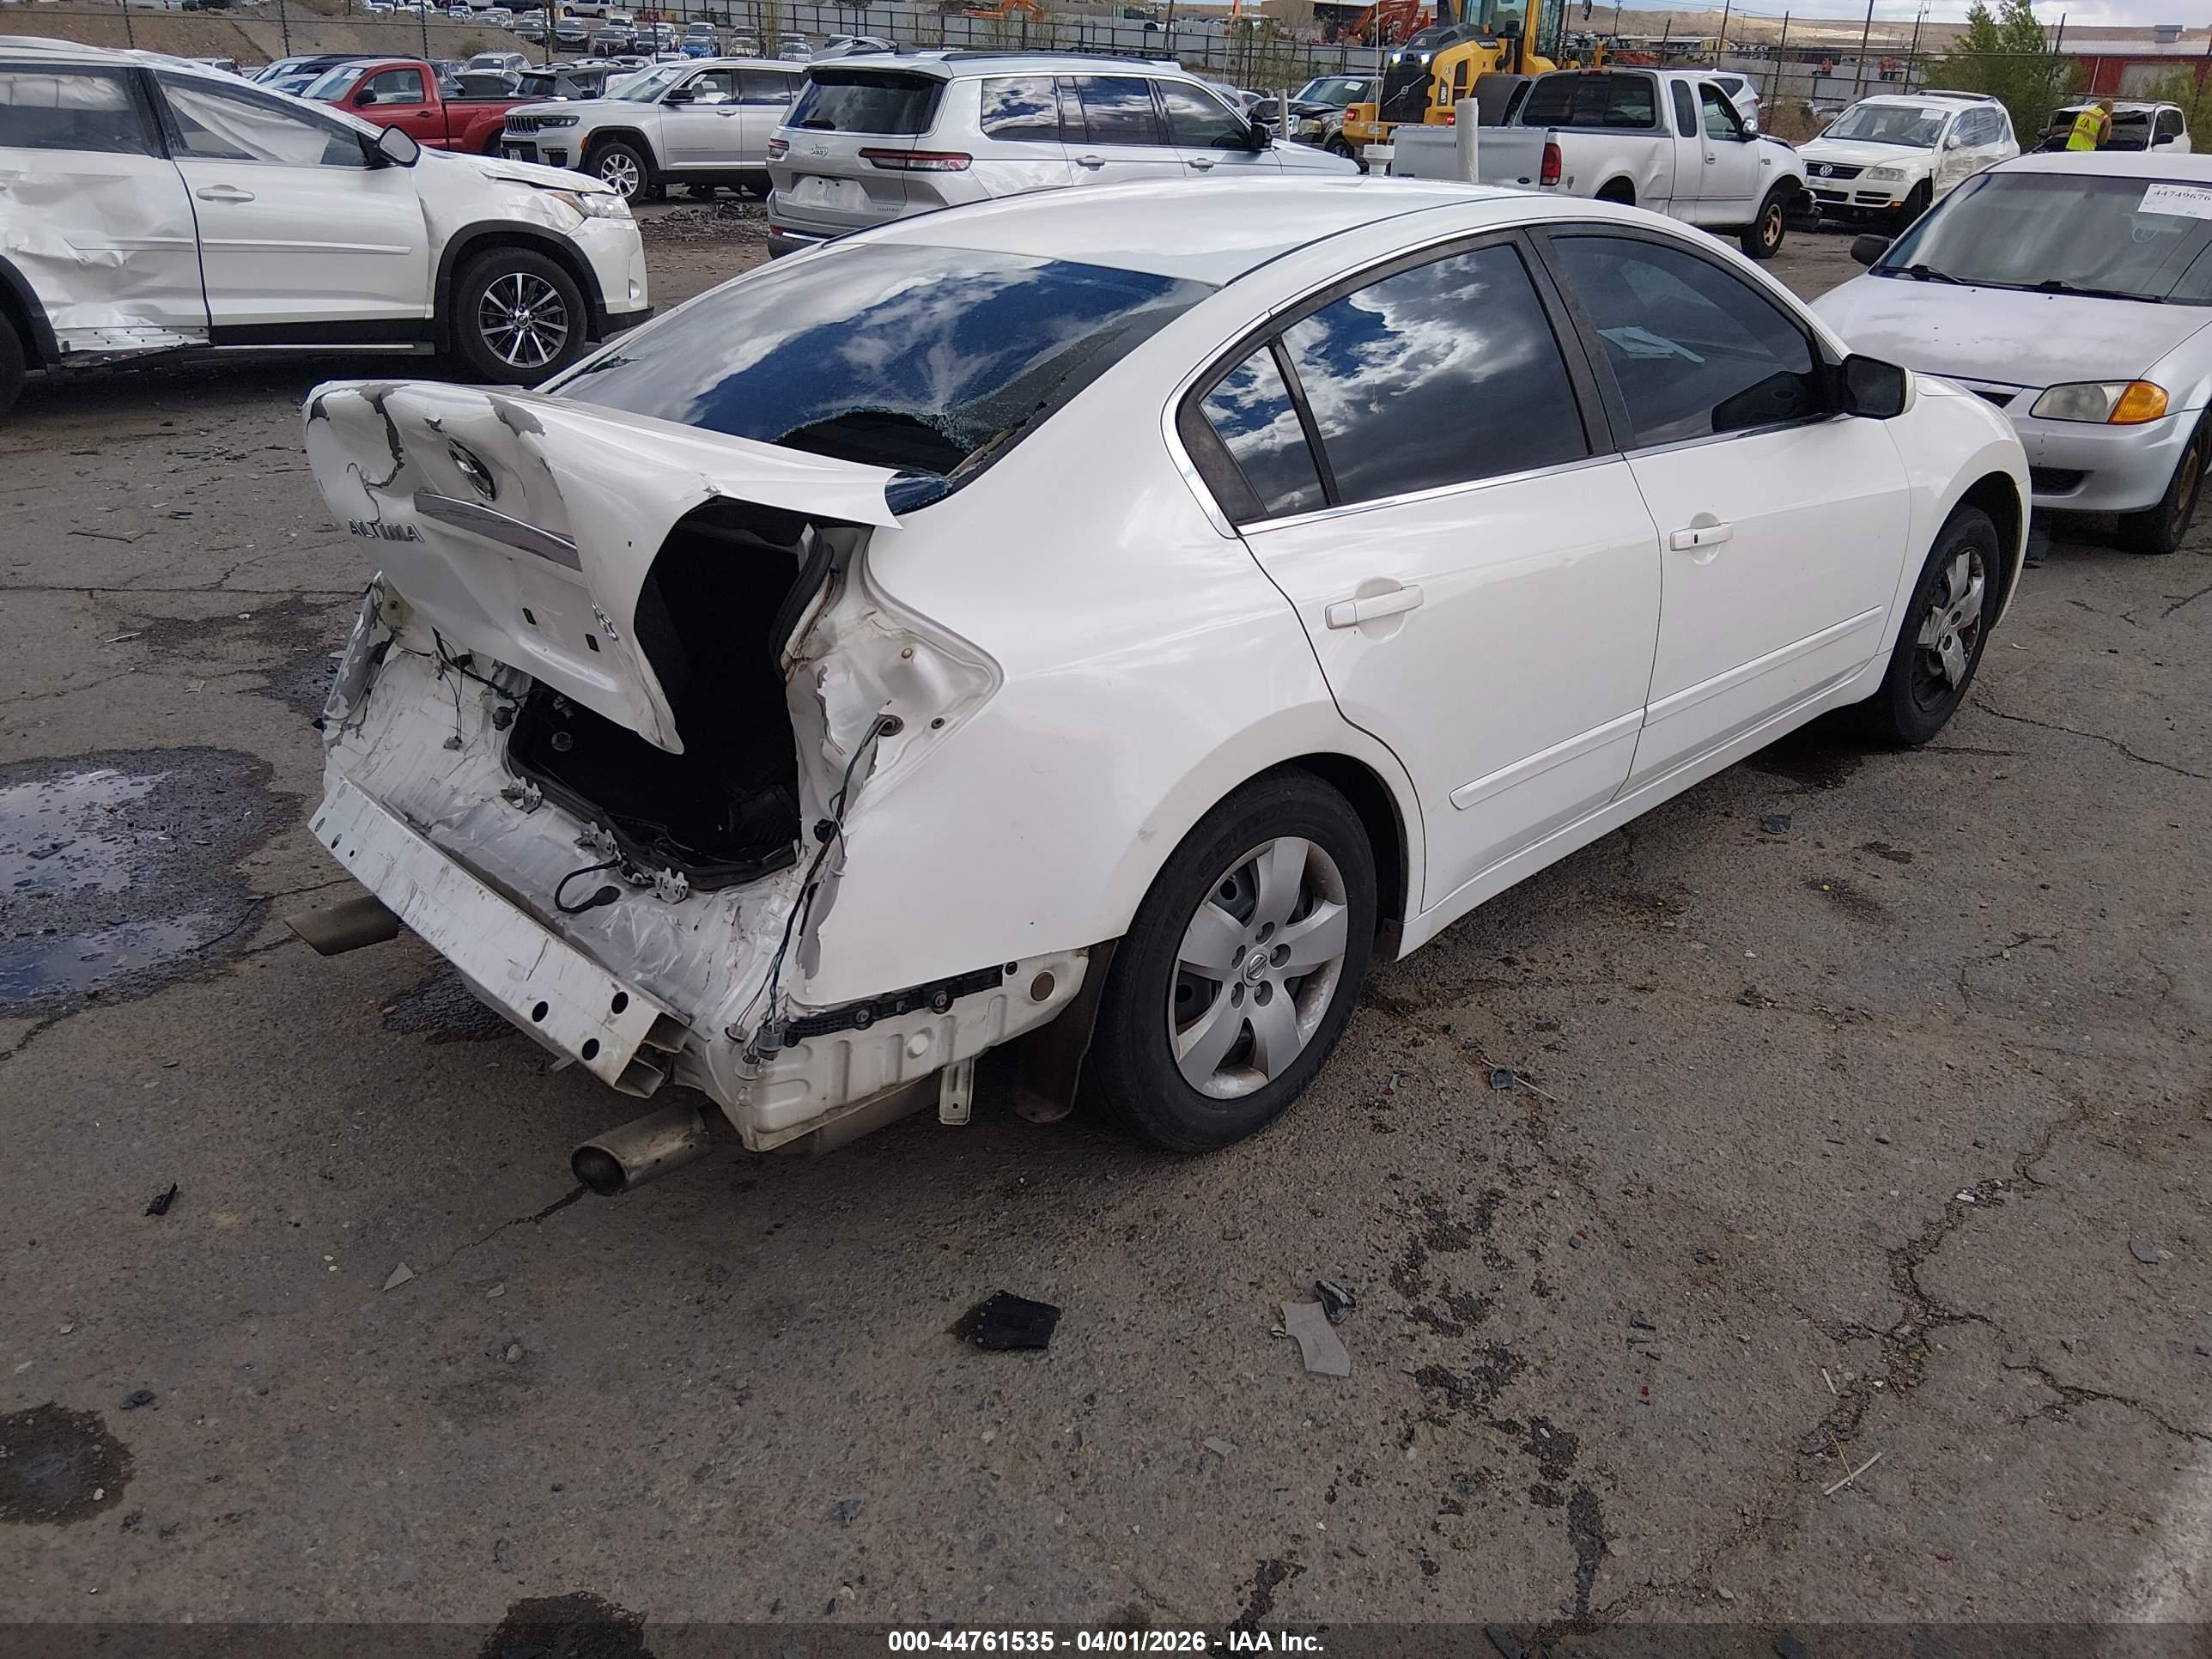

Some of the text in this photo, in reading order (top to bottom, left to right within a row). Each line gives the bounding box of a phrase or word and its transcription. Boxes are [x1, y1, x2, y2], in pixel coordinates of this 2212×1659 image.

[811, 144, 829, 156] Jeep
[2154, 190, 2211, 201] 44749676
[348, 518, 425, 543] ALTIMA
